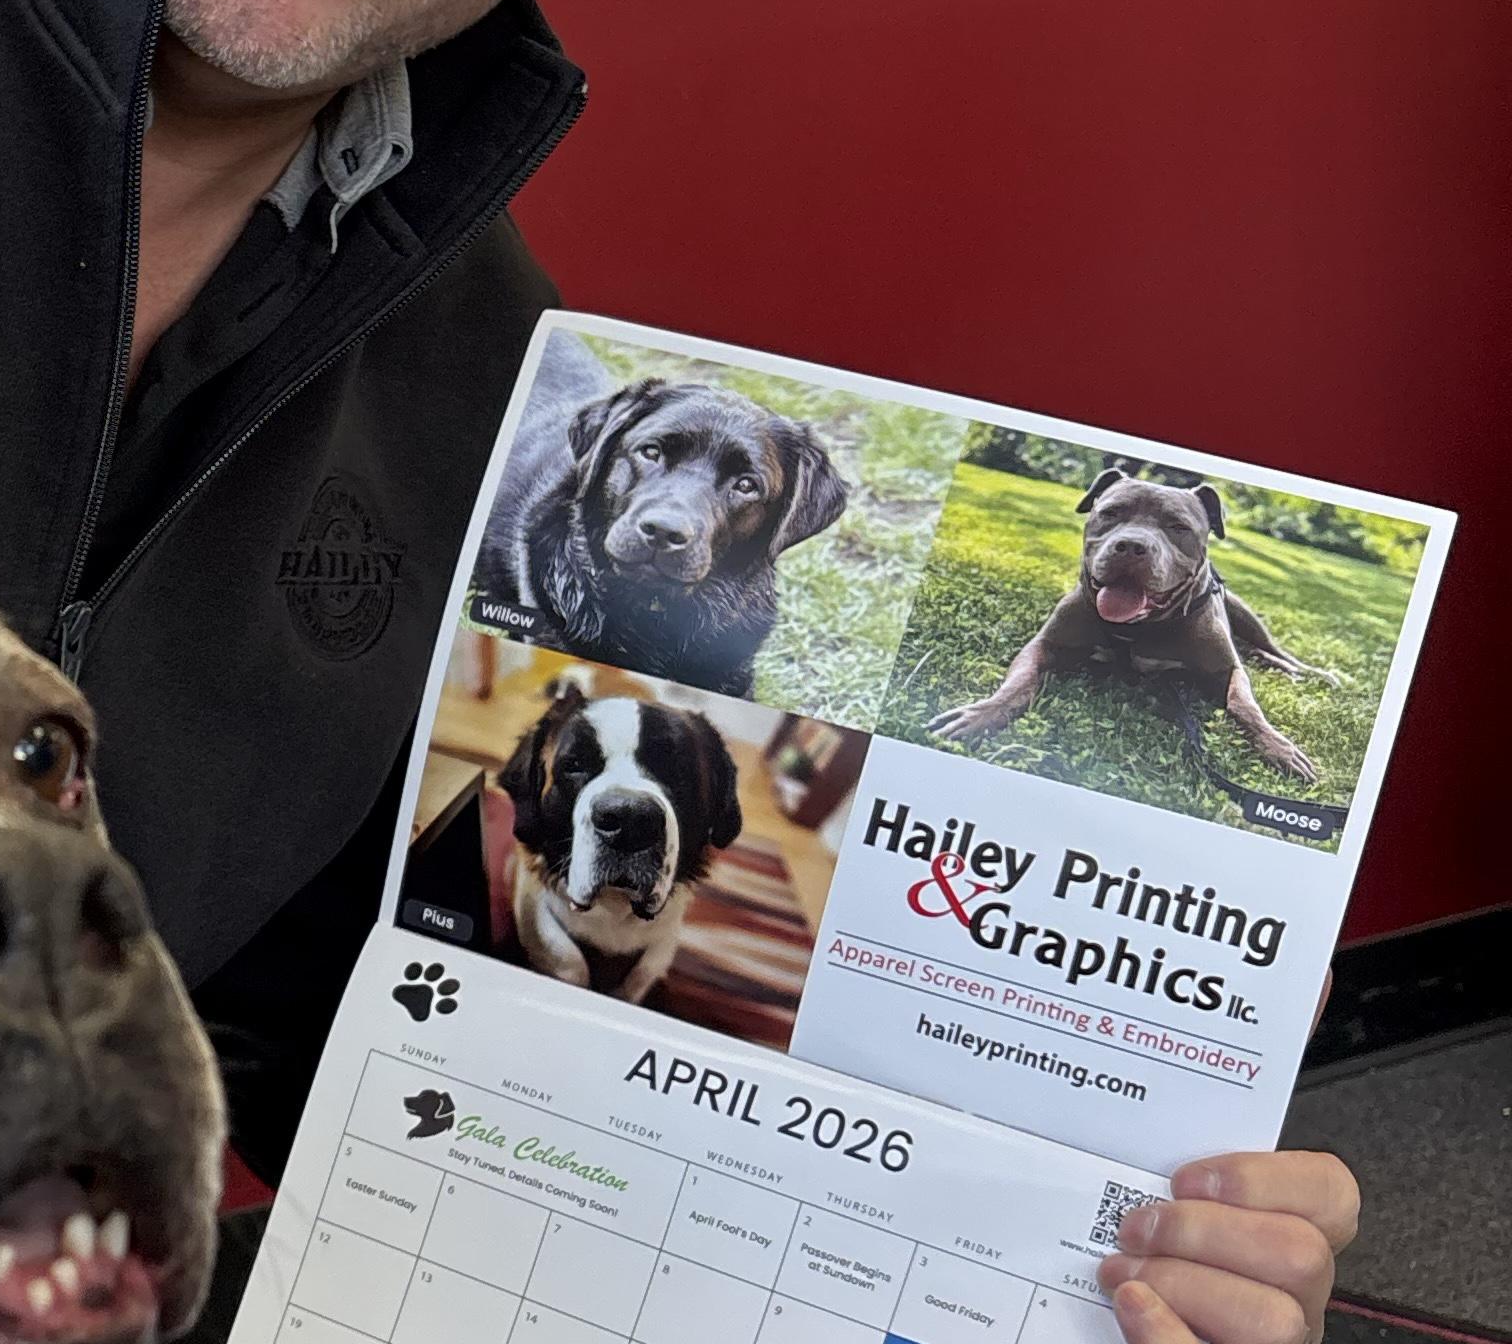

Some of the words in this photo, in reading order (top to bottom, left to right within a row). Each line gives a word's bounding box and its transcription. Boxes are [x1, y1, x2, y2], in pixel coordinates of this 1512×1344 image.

[481, 601, 535, 629] Willow
[1254, 800, 1322, 833] Moose
[862, 797, 1036, 893] Hailey
[1051, 848, 1287, 968] Printing
[422, 908, 455, 930] Pius
[906, 851, 1002, 931] &
[967, 901, 1226, 1013] Graphics
[828, 937, 917, 979] Apparel
[919, 962, 996, 1001] Screen
[1001, 987, 1090, 1035] Printing
[1095, 1016, 1116, 1037] &
[1123, 1022, 1262, 1082] Embroidery
[915, 1012, 1148, 1103] haileyprinting.com
[623, 1048, 762, 1127] APRIL
[776, 1096, 915, 1173] 2026
[345, 1146, 353, 1157] 5
[456, 1114, 506, 1149] Gala
[513, 1137, 630, 1192] Celebration
[400, 1043, 447, 1066] SUNDAY
[501, 1078, 554, 1104] MONDAY
[607, 1116, 663, 1143] TUESDAY
[706, 1150, 784, 1185] WEDNESDAY
[826, 1191, 895, 1224] THURSDAY
[955, 1236, 1002, 1261] FRIDAY
[1062, 1274, 1105, 1297] SATU
[447, 1148, 472, 1166] Stay
[508, 1170, 544, 1191] Details
[545, 1183, 587, 1208] Coming
[589, 1199, 619, 1218] Soon!
[345, 1177, 378, 1197] Easter
[379, 1189, 418, 1214] Sunday
[447, 1185, 455, 1195] 6
[554, 1224, 562, 1234] 7
[688, 1210, 715, 1228] April
[716, 1219, 747, 1239] Fool's
[748, 1230, 772, 1249] Day
[803, 1216, 812, 1227] 2
[319, 1232, 332, 1244] 12
[662, 1264, 670, 1275] 8
[800, 1242, 852, 1270] Passover
[852, 1259, 892, 1284] Begins
[807, 1259, 822, 1272] at
[823, 1265, 876, 1292] Sundown
[920, 1256, 928, 1266] 3
[421, 1271, 433, 1284] 13
[774, 1305, 783, 1316] 9
[924, 1294, 956, 1312] Good
[958, 1305, 996, 1328] Friday
[1039, 1298, 1047, 1308] 4
[290, 1317, 302, 1330] 19
[526, 1312, 538, 1325] 14
